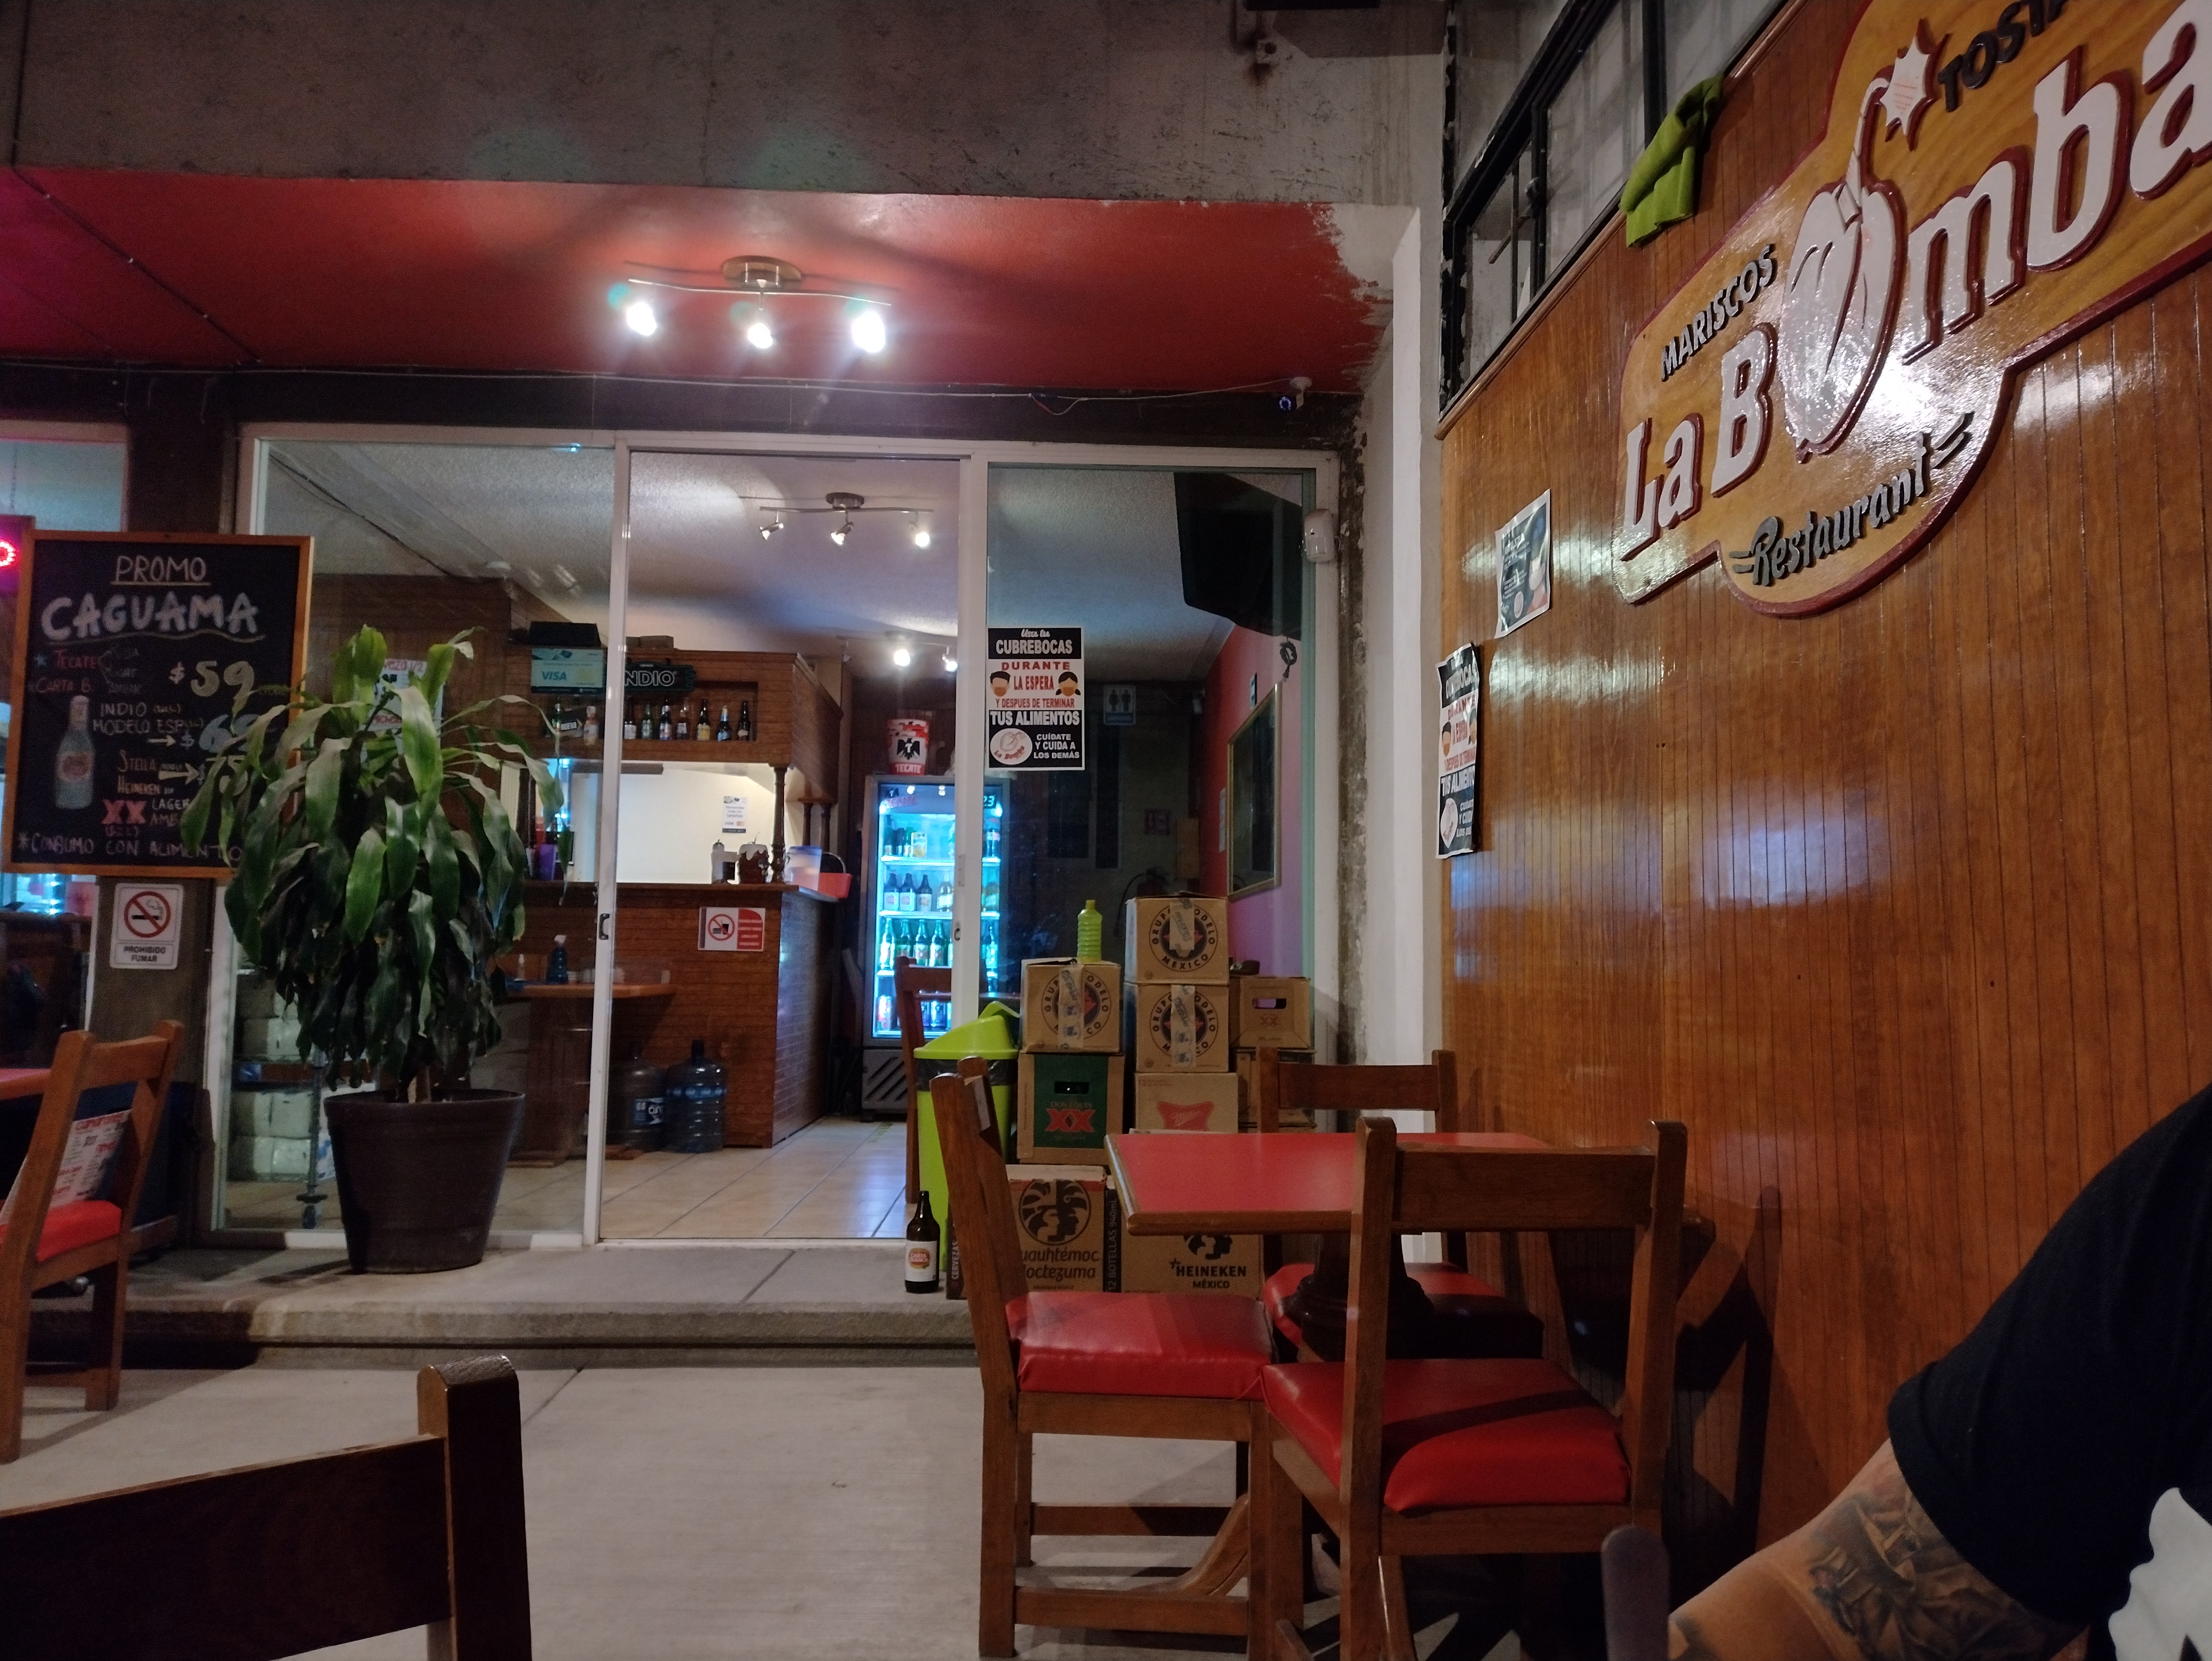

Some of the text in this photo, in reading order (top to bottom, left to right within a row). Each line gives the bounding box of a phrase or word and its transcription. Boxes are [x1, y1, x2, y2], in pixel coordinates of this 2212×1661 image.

[1938, 0, 2063, 112] TOST
[1662, 244, 1778, 382] MARISCOS
[1748, 432, 1929, 587] Restaurant
[115, 556, 207, 582] PROMO
[41, 591, 259, 641] CAGUAMA
[996, 639, 1073, 654] CUBREBOCAS
[1001, 661, 1070, 671] DURANTE
[542, 671, 567, 681] VISA
[624, 670, 675, 687] NDIO
[1013, 675, 1054, 690] LA ESPERA
[100, 701, 147, 717] INDIO
[995, 698, 1075, 708] Y DESPUES DE TERMINAR
[990, 710, 1080, 726] TUS ALIMENTOS
[93, 719, 150, 736] MODELO
[1034, 741, 1076, 750] Y CUIDA A
[118, 749, 156, 772] STELLA
[1051, 750, 1080, 759] DEMÁS
[895, 764, 922, 774] TECATE
[101, 799, 148, 825] XX
[105, 839, 140, 857] CON
[1194, 908, 1216, 945] ODELO
[123, 945, 166, 954] PROHIBIDO
[1086, 974, 1109, 1012] ODELO
[1194, 994, 1216, 1032] ODELO
[1044, 1107, 1096, 1133] XX
[1022, 1246, 1099, 1262] uauhtémoc
[1108, 1230, 1117, 1278] BOTELLAS
[1023, 1264, 1096, 1282] octezuma
[1176, 1265, 1247, 1277] HEINEKEN
[1193, 1278, 1230, 1289] MÉXICO
